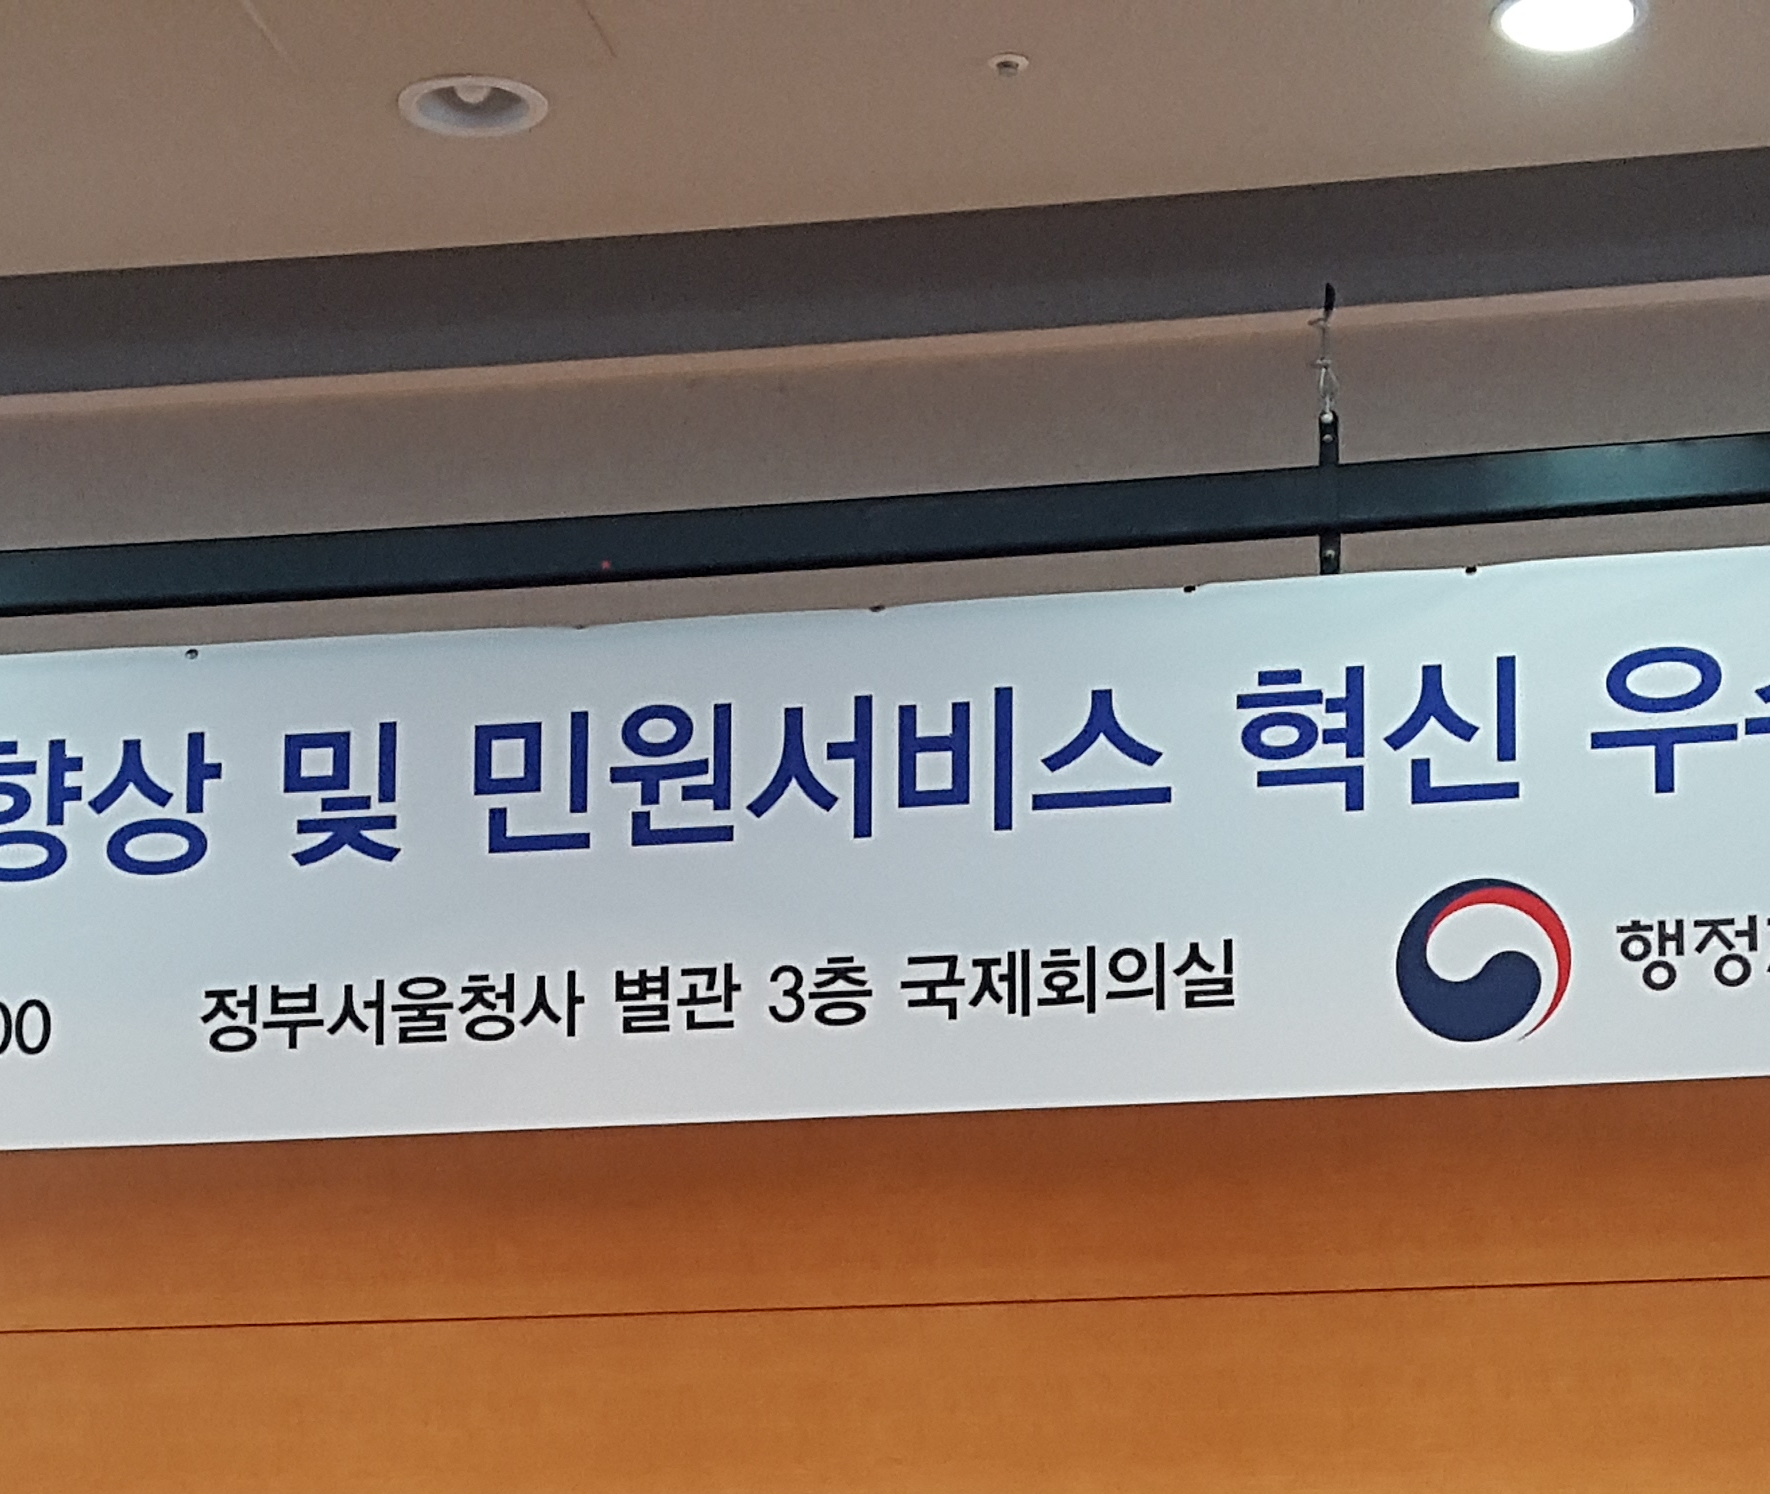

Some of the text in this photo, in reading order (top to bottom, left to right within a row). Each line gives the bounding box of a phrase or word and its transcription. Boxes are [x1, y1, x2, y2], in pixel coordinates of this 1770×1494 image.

[283, 721, 402, 867] 및
[473, 686, 1172, 854] 민원서비스
[1236, 655, 1520, 812] 혁신
[200, 969, 585, 1053] 정부서울청사
[615, 962, 742, 1034] 별관
[768, 955, 873, 1027] 3층
[900, 938, 1235, 1021] 국제회의실
